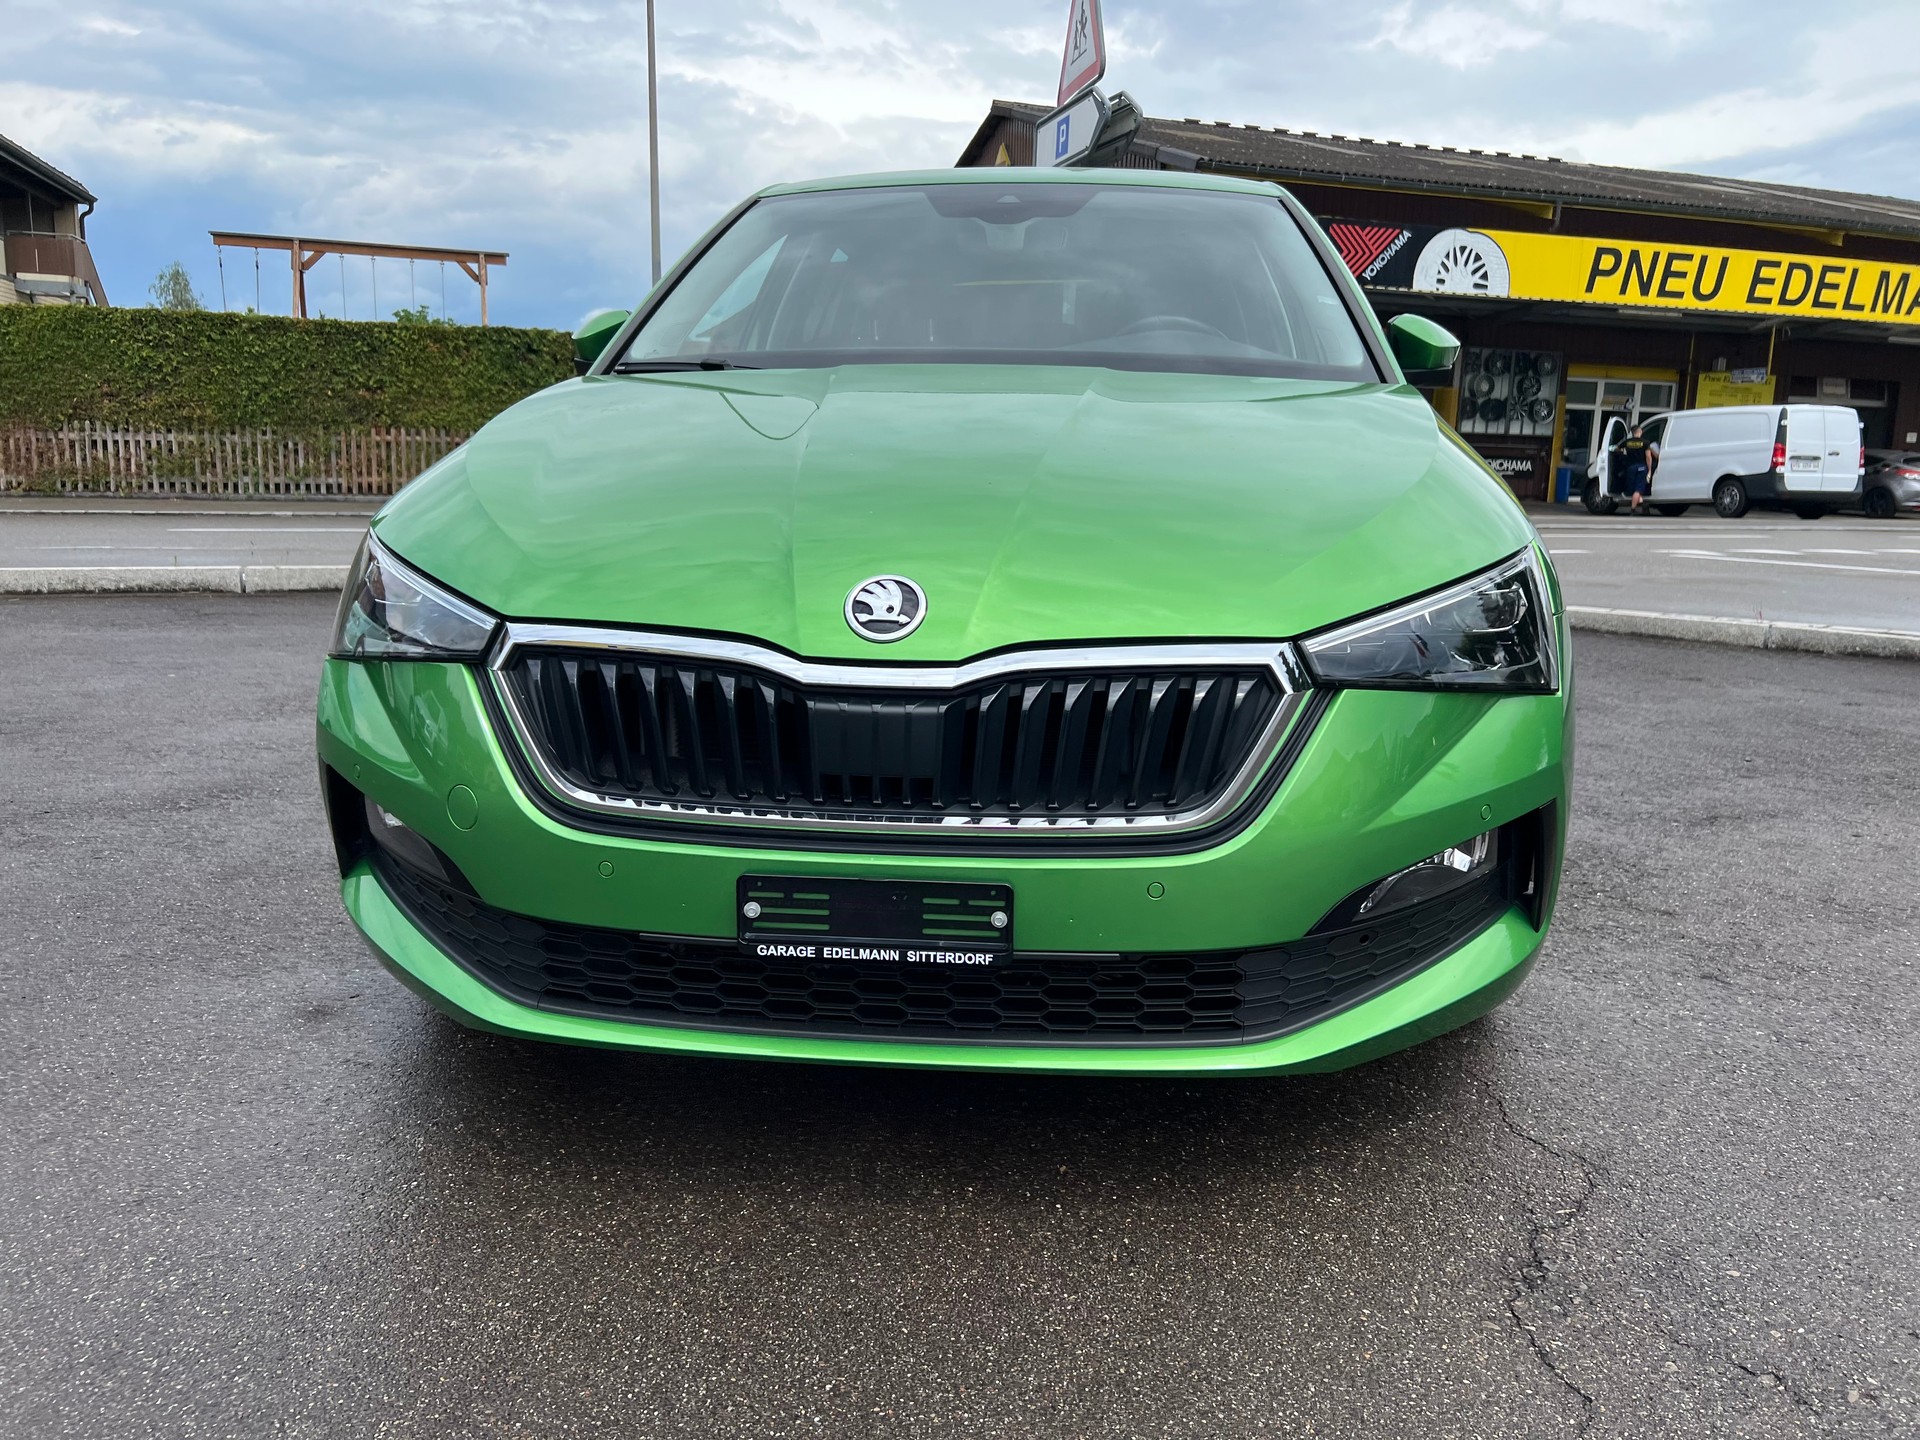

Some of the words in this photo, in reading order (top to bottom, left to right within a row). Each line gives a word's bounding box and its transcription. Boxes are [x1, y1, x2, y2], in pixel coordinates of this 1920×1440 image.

[1059, 123, 1067, 153] P
[1361, 230, 1412, 281] YOKOHAMA
[1584, 246, 1730, 302] PNEU
[1484, 459, 1532, 471] OKOHAMA
[756, 944, 816, 958] GARAGE
[823, 947, 899, 961] EDELMANN
[906, 950, 994, 965] SITTERDORF
